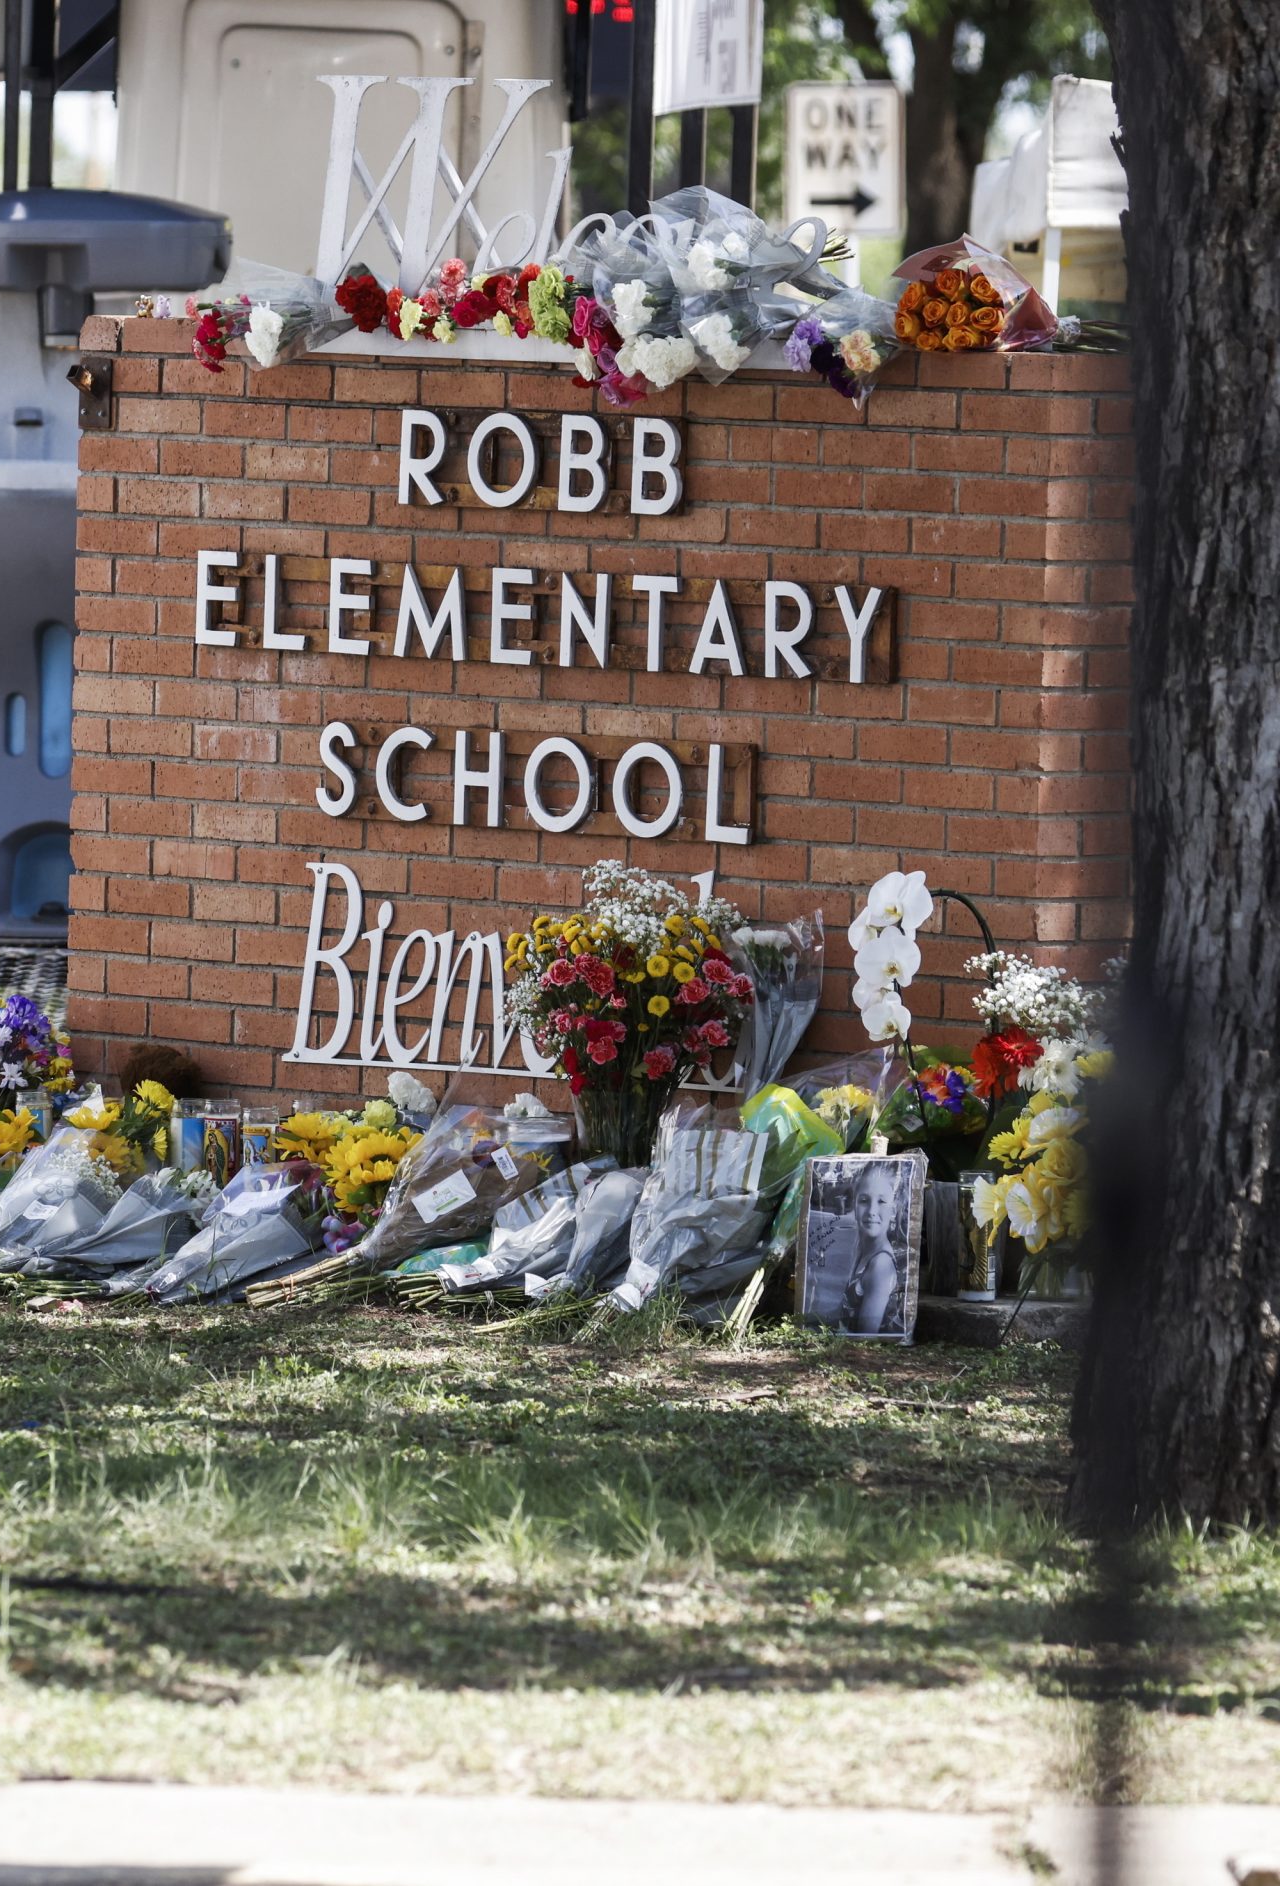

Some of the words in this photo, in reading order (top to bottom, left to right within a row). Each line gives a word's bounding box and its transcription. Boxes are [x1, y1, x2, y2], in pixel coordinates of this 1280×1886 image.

[804, 97, 883, 130] ONE
[805, 140, 888, 169] WAY
[398, 409, 683, 515] ROBB
[194, 550, 884, 684] ELEMENTARY
[315, 721, 752, 846] SCHOOL
